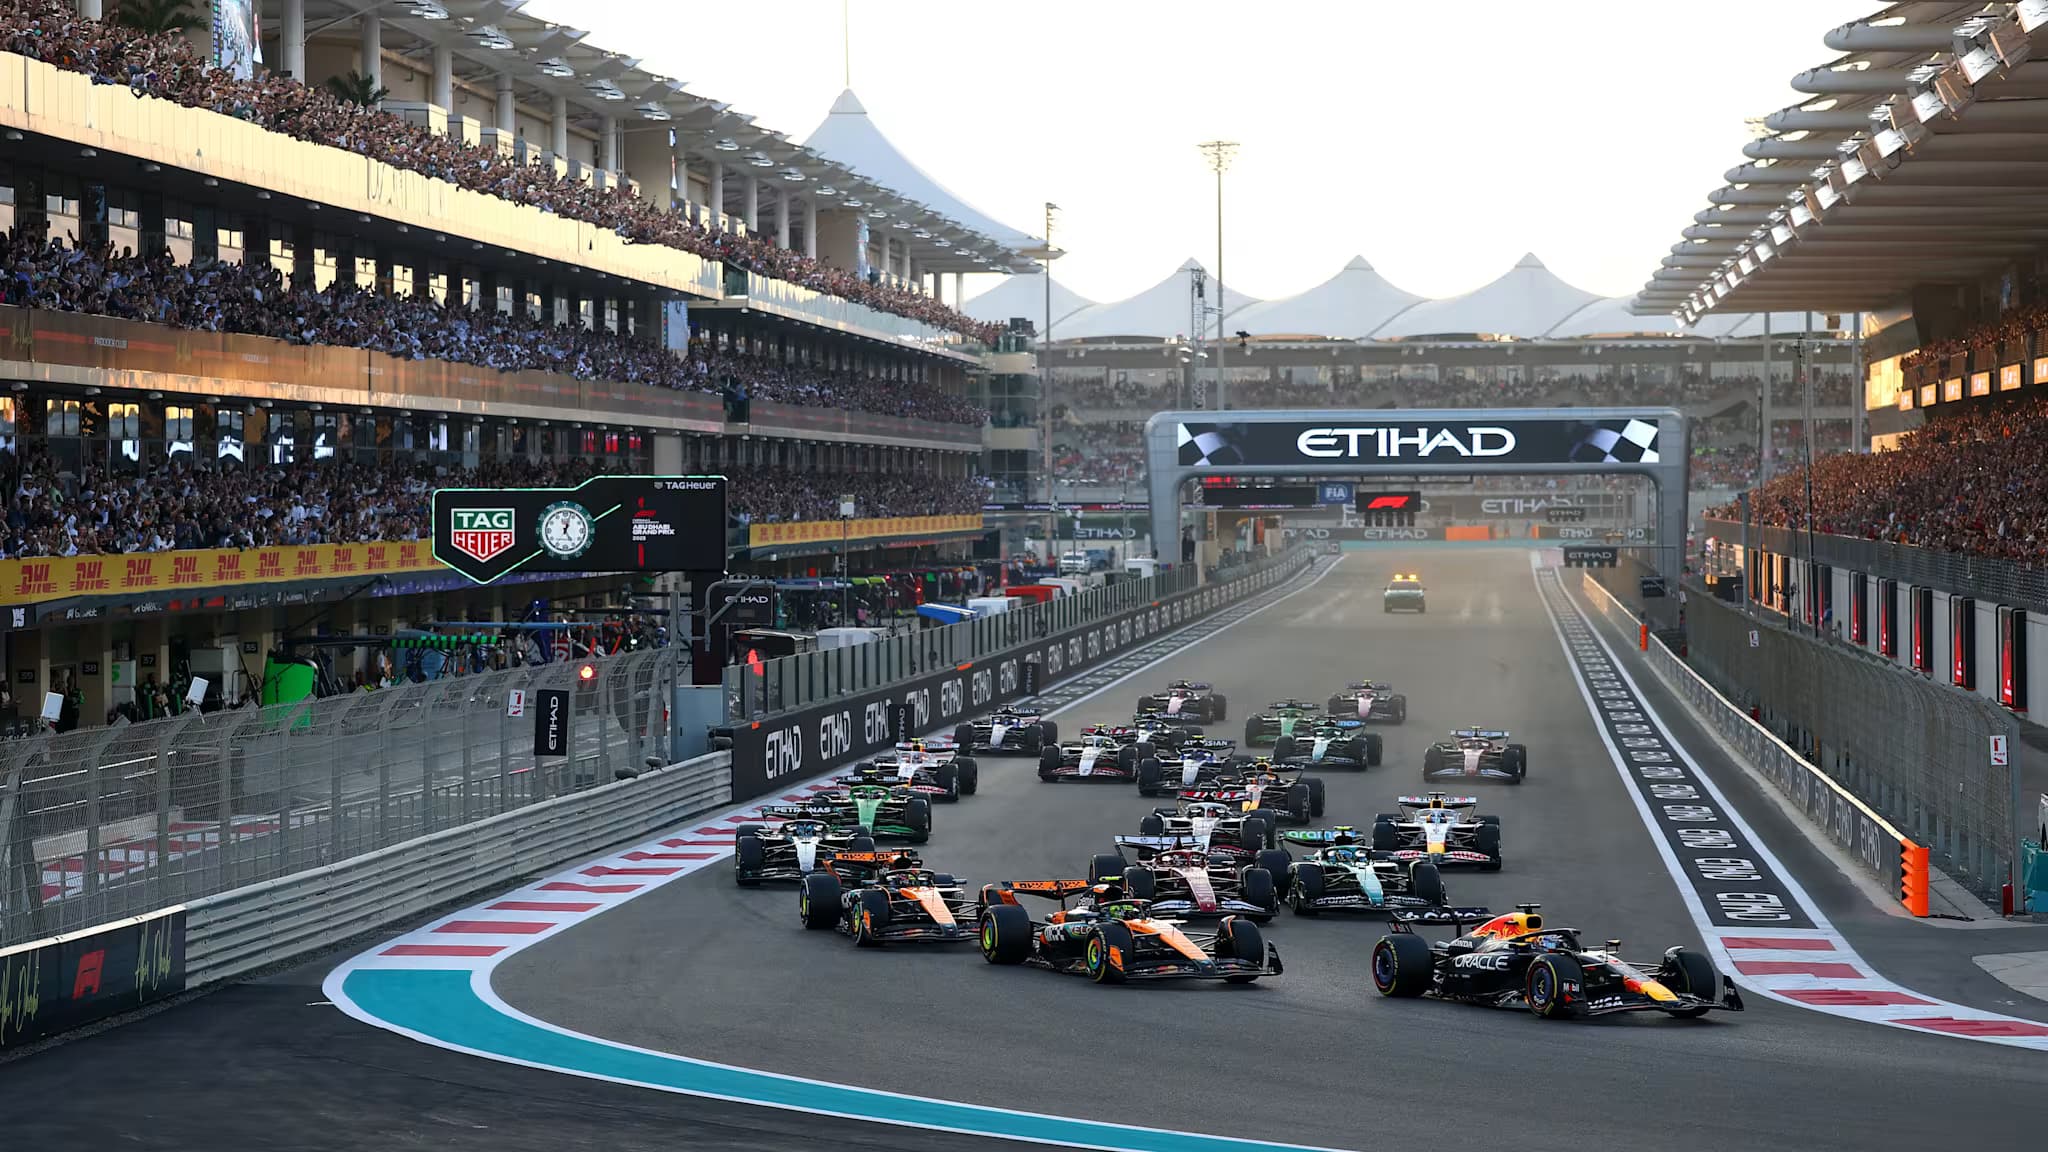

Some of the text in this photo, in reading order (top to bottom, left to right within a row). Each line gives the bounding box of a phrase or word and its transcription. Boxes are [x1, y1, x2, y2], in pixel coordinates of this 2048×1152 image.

[1297, 427, 1516, 457] ETIHAD
[1326, 487, 1346, 498] FIA
[457, 512, 509, 528] TAG
[1073, 527, 1137, 539] ETIHAD
[1364, 529, 1428, 540] ETIHAD
[455, 532, 511, 557] HEUER
[1569, 551, 1612, 559] ETIHAD
[725, 595, 769, 604] EIHAD
[1000, 658, 1017, 694] ETIHAD
[972, 668, 992, 706] ETIHAD
[941, 678, 964, 718] ETIHAD
[548, 696, 559, 750] ETIHAD
[864, 699, 892, 744] ETIHA
[820, 710, 851, 761] ETIHAD
[765, 725, 802, 780] ETIHAD
[1860, 815, 1881, 871] ETIHAD
[1019, 882, 1044, 890] OKX
[1316, 895, 1359, 905] aramco
[1453, 954, 1511, 971] ORACLE
[1563, 981, 1580, 992] Mobil
[1588, 996, 1623, 1009] VISA
